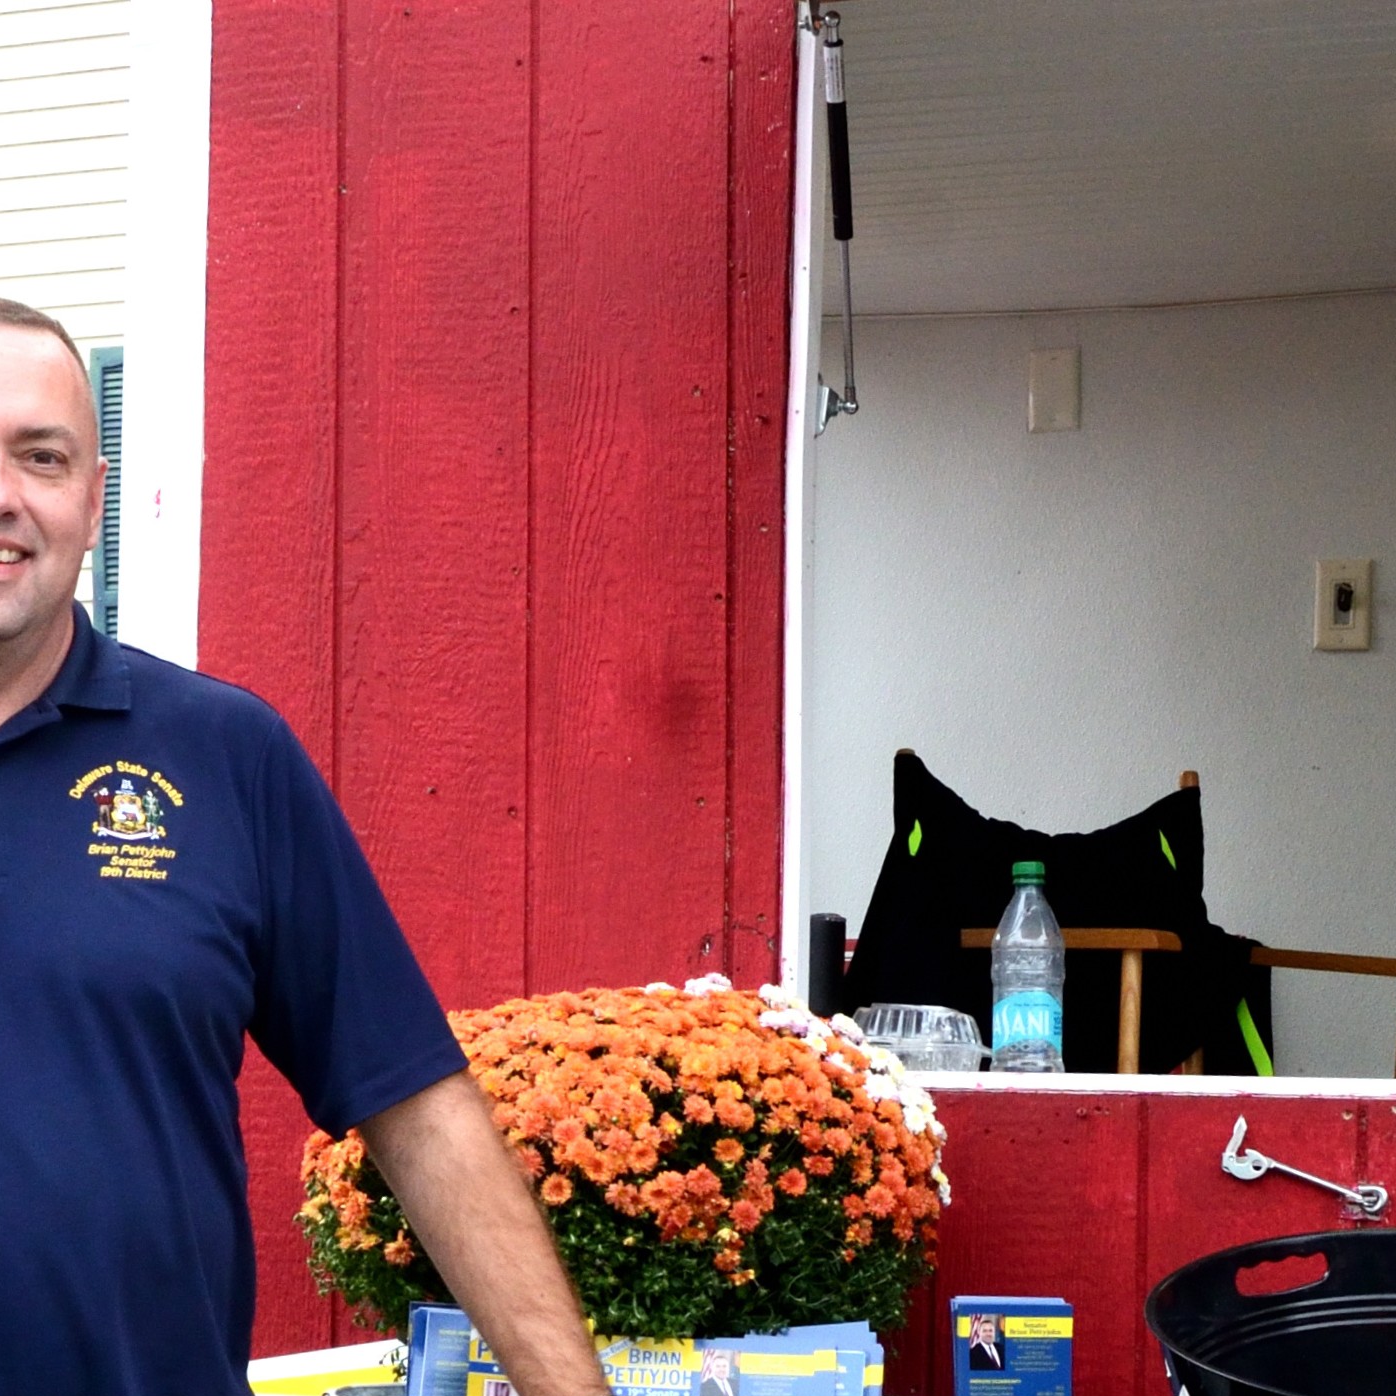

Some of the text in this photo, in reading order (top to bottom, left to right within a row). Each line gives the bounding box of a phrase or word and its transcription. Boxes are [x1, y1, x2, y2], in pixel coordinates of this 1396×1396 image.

[68, 761, 184, 806] Delaware State Senate
[88, 843, 176, 858] Brian Pettyjohn
[110, 855, 156, 867] Senator
[100, 866, 167, 879] 19th District
[629, 1348, 681, 1365] BRIAN
